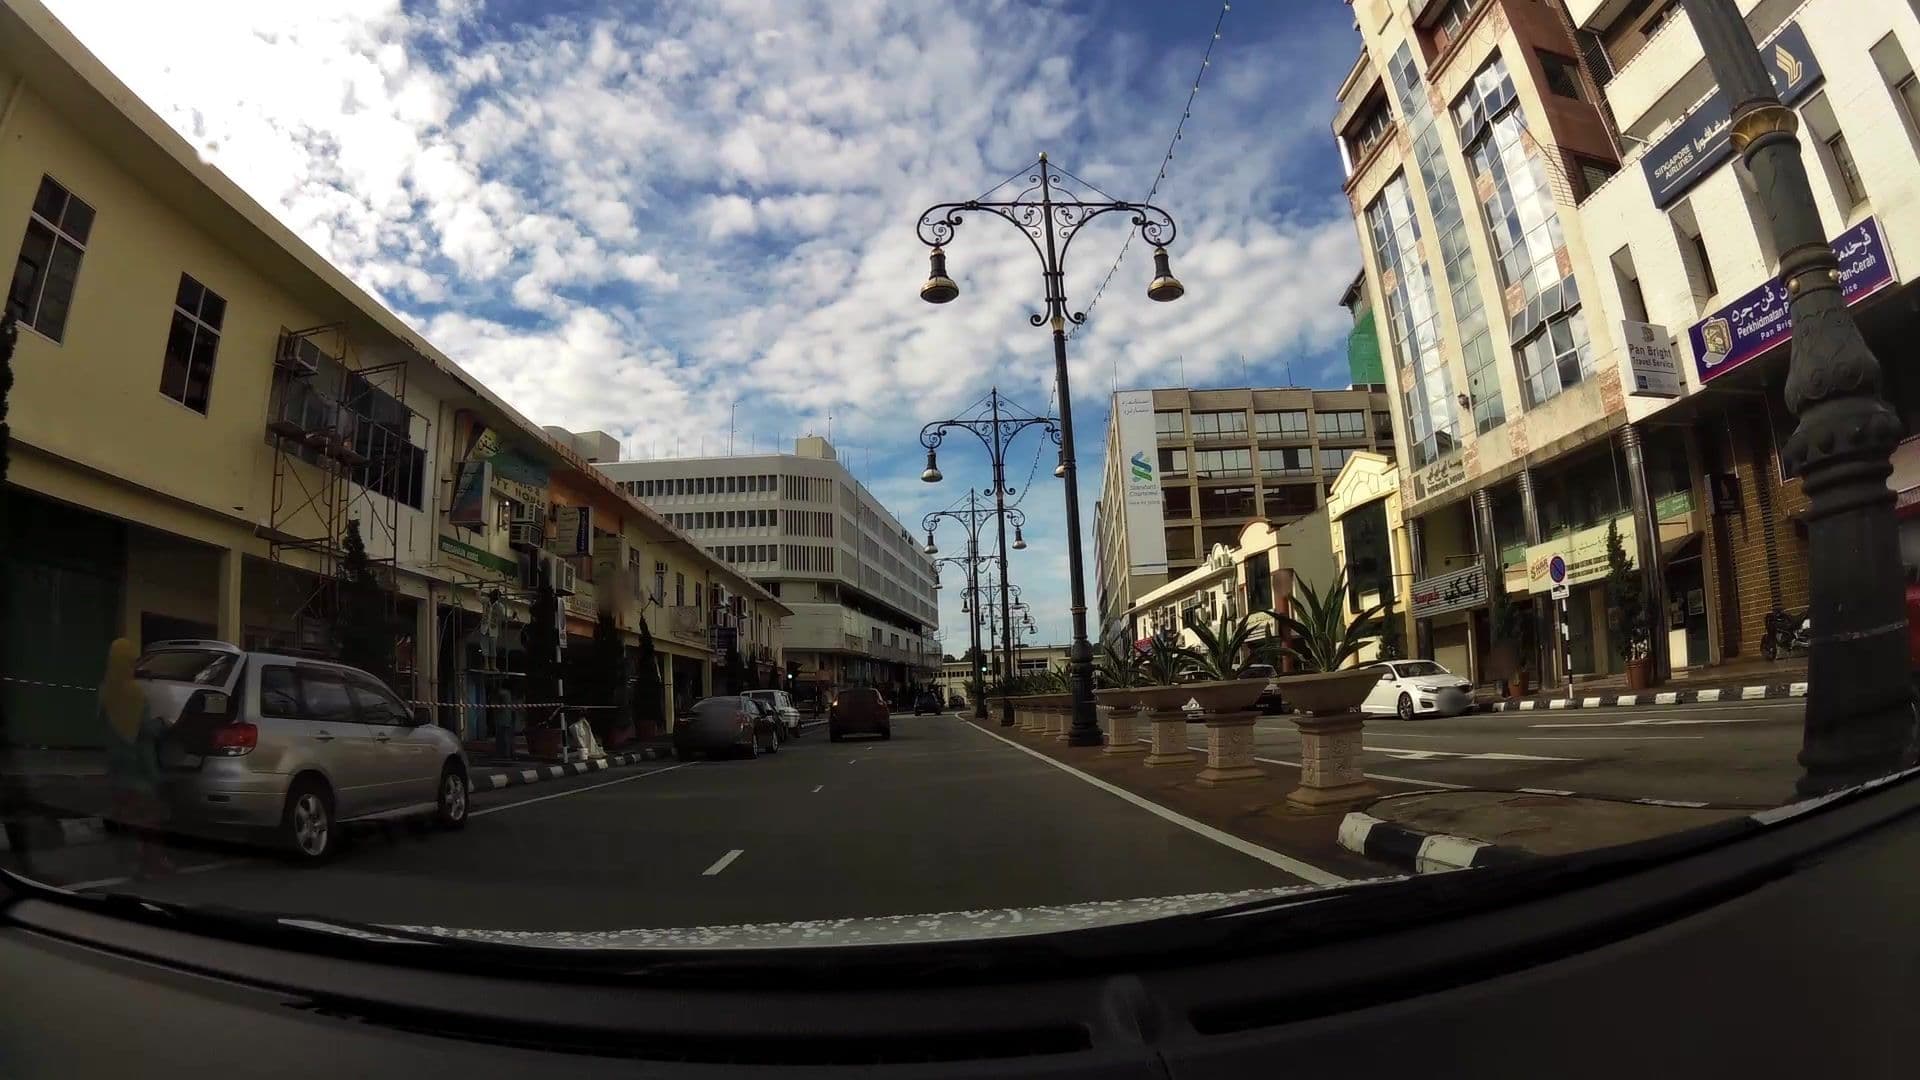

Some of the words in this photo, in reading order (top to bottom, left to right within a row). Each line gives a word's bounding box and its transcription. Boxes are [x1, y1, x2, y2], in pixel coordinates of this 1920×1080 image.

[1654, 144, 1691, 178] SINGAPORE
[1665, 152, 1694, 180] AIRLINES
[1737, 307, 1784, 339] Perkhidmatan
[1760, 329, 1775, 341] Pan
[1776, 319, 1792, 332] Brig
[1628, 344, 1645, 356] Pan
[1647, 346, 1672, 359] Bright
[1632, 356, 1650, 366] Travel
[1652, 359, 1674, 368] Service
